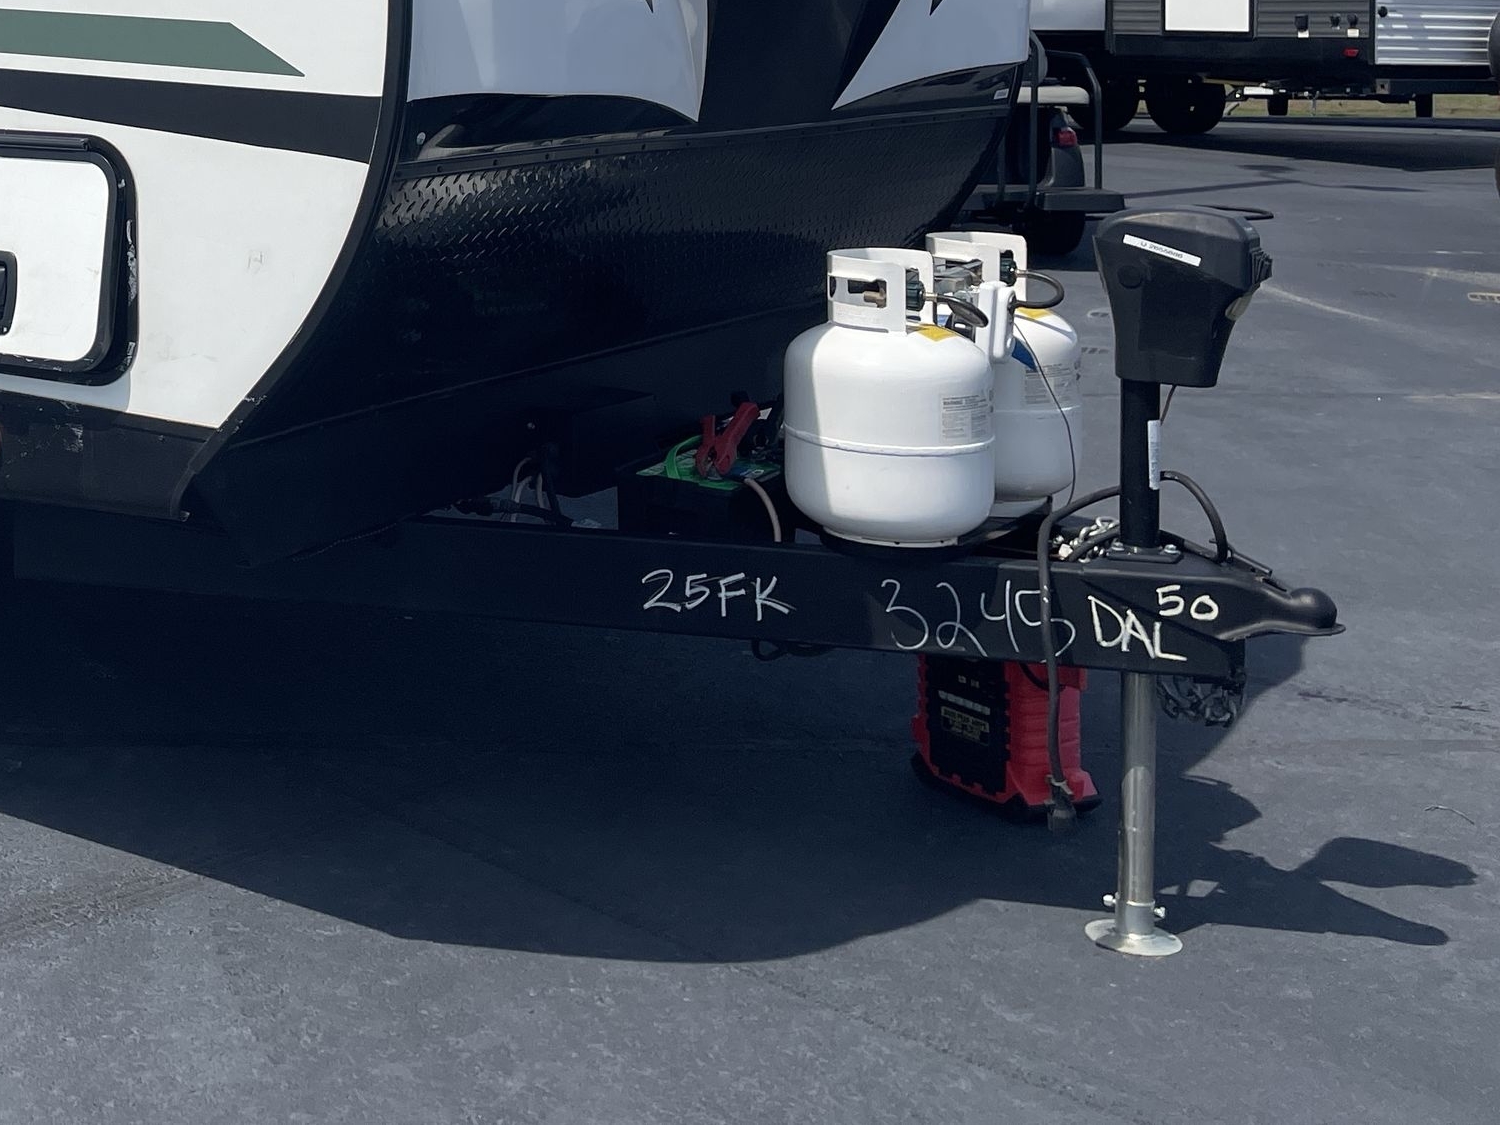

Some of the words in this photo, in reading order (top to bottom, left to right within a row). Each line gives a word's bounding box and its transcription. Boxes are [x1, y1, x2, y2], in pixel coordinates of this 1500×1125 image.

[642, 568, 797, 622] 25FK
[1087, 594, 1188, 662] DAL
[1155, 584, 1219, 621] 50
